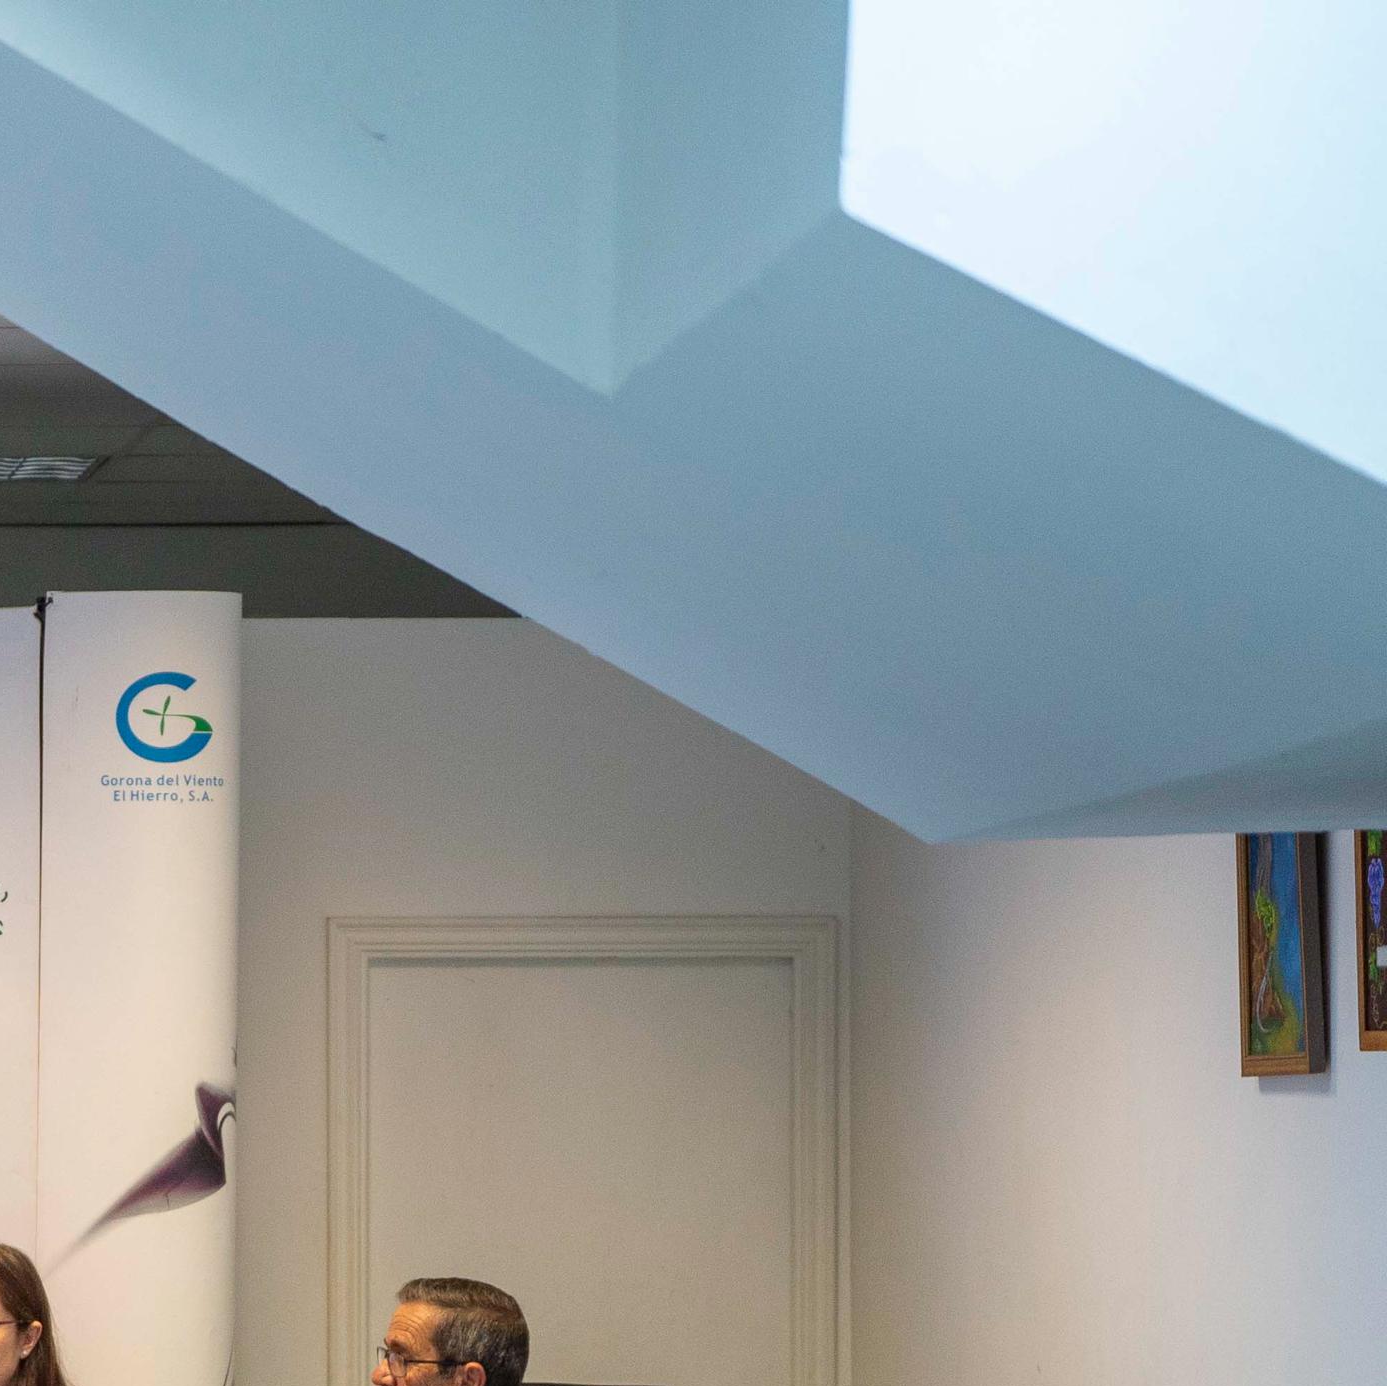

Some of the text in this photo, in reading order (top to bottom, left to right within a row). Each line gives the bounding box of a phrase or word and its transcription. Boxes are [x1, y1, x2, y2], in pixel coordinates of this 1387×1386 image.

[100, 775, 225, 787] Gorona del Viento
[113, 790, 214, 803] El Hierro, S.A.
